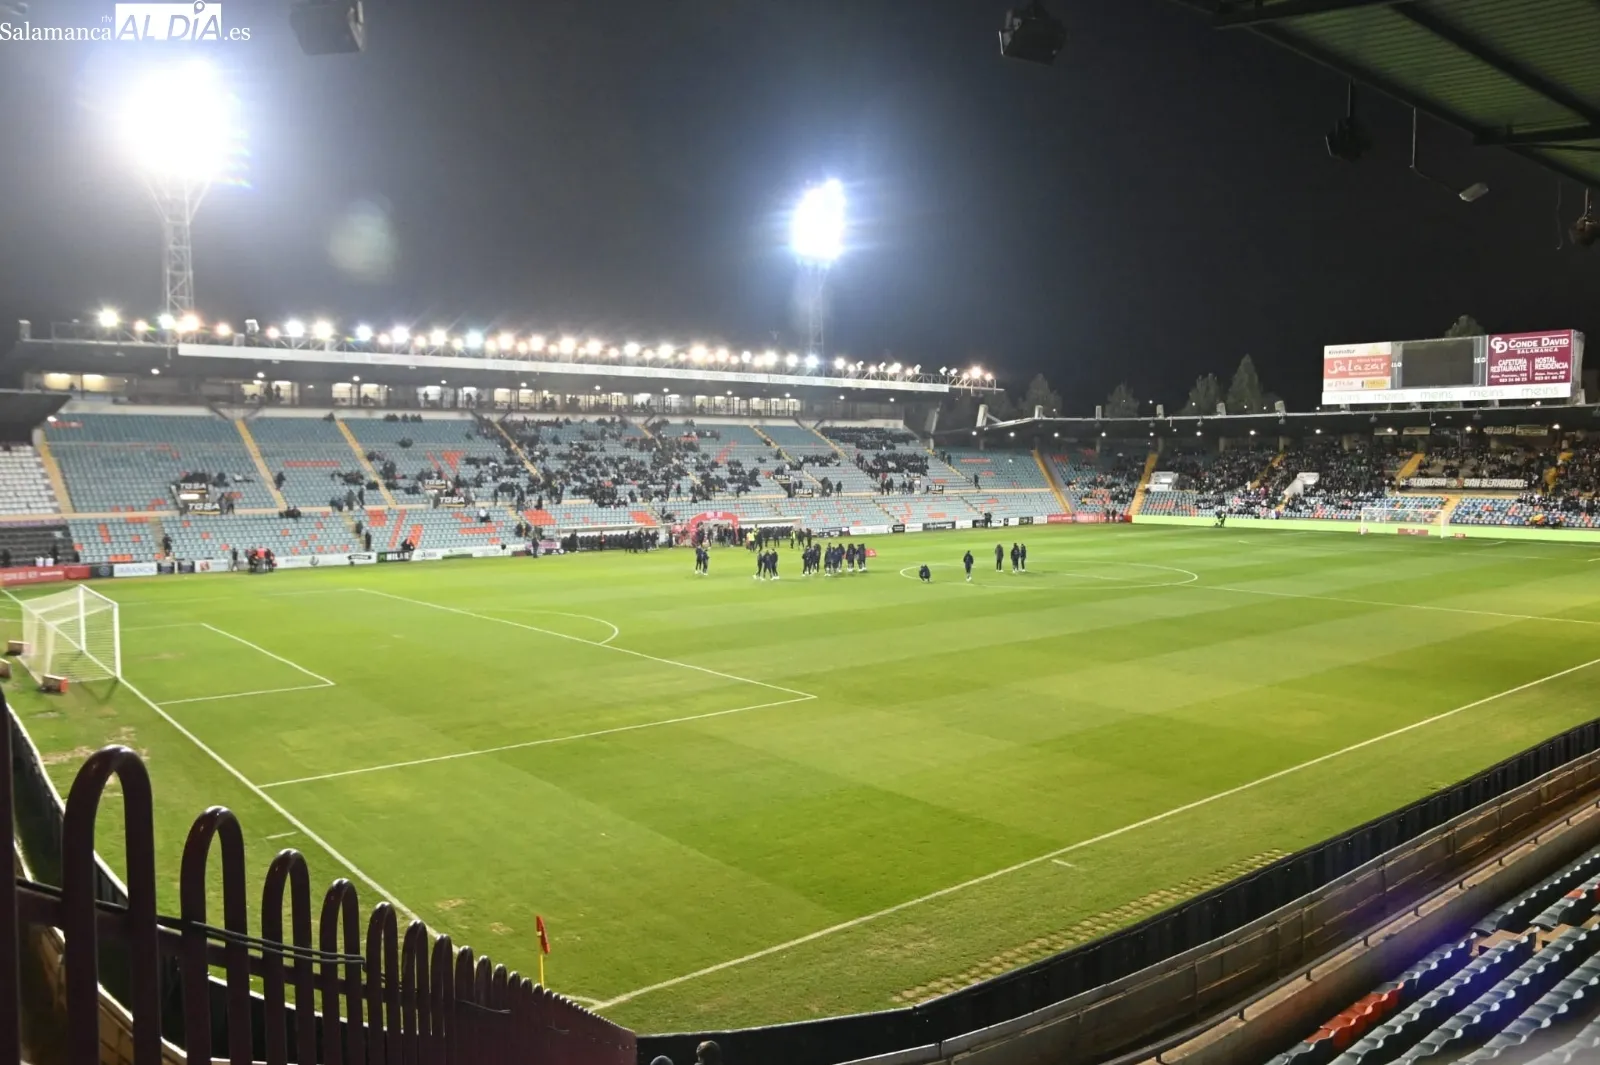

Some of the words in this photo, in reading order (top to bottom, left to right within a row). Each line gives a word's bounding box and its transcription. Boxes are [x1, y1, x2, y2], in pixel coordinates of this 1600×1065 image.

[1509, 339, 1538, 348] CONDE
[1541, 337, 1569, 346] DAVID
[1328, 359, 1388, 374] Salazar
[1535, 362, 1569, 370] RESIDENCIA
[1420, 388, 1454, 399] meins
[1469, 387, 1505, 398] meins
[1521, 386, 1559, 397] meins
